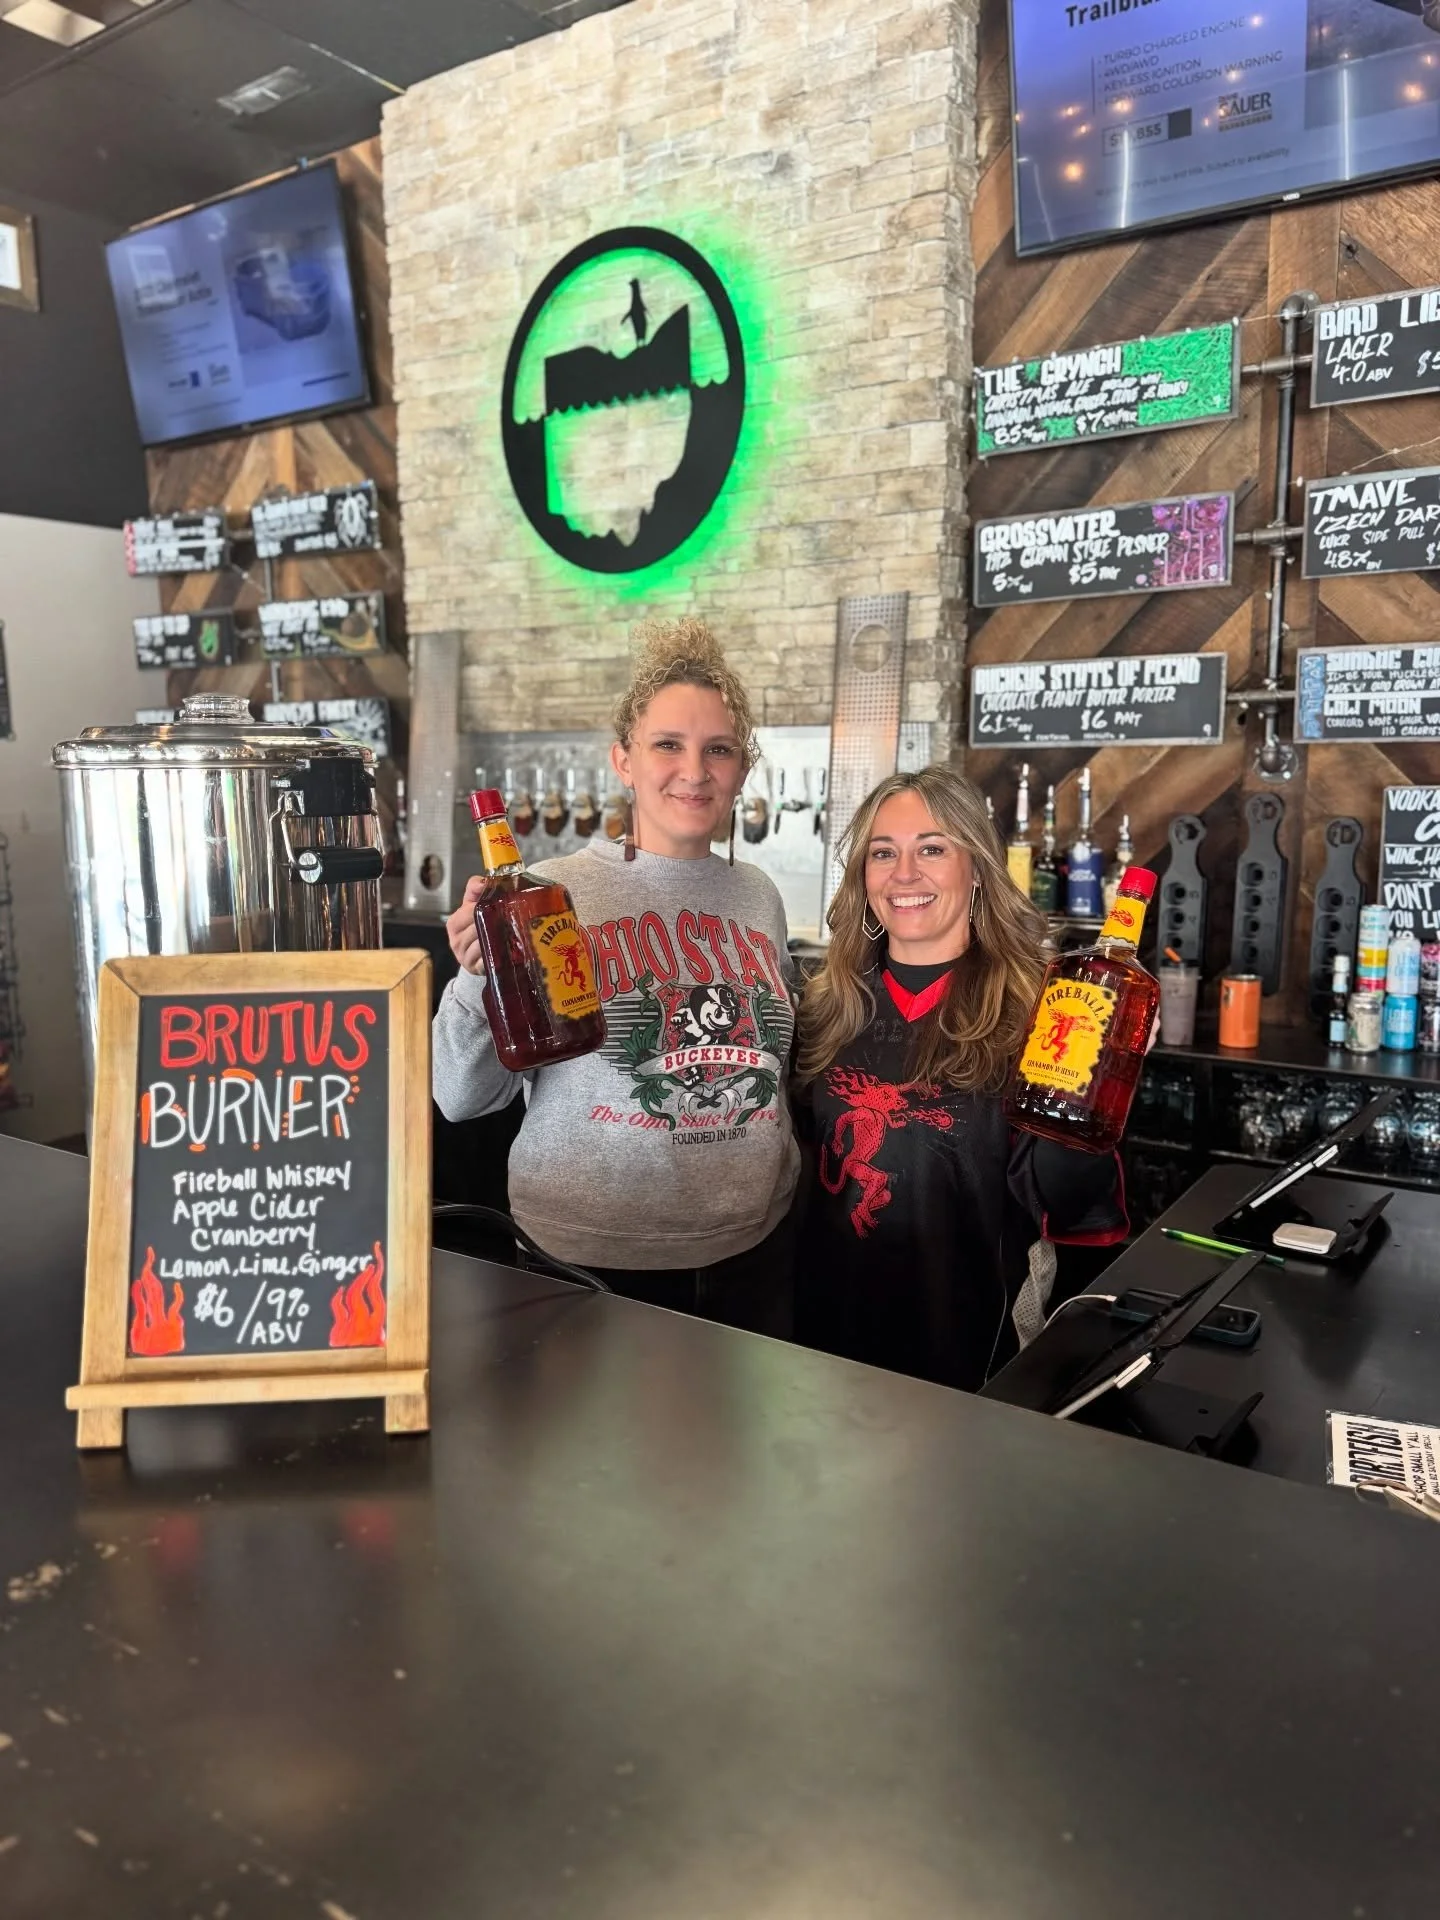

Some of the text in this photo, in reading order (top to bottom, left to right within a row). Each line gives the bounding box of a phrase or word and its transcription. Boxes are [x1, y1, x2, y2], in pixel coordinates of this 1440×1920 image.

[1065, 0, 1160, 27] Trailb
[1103, 16, 1245, 64] TURBO CHARGED ENGINE
[1103, 58, 1201, 92] KEYLESS IGNITION
[1104, 83, 1161, 107] FWARD
[1225, 50, 1283, 76] WARNING
[1219, 92, 1271, 119] SAUER
[1319, 303, 1378, 341] BIRD
[1325, 332, 1394, 365] LAGER
[980, 345, 1122, 397] THE GRYNCH
[1331, 360, 1367, 385] 4.0
[1365, 366, 1394, 382] ABV
[1309, 477, 1417, 515] TMAVE
[980, 509, 1122, 554] GROSSVATER
[1313, 508, 1386, 536] CZECH
[1362, 528, 1391, 545] SIDE
[1397, 525, 1425, 541] PULL
[1068, 560, 1098, 585] $5
[1116, 659, 1141, 687] OF
[1131, 685, 1177, 705] PORTER
[1368, 698, 1421, 716] MOON
[1081, 708, 1109, 731] $6
[1045, 986, 1105, 1017] FIREBALL
[160, 1000, 377, 1071] BRUTUS
[664, 1047, 762, 1072] BUCKEYES
[149, 1074, 352, 1149] BURNER
[589, 1105, 623, 1124] The
[677, 1109, 725, 1128] State
[672, 1126, 747, 1145] FOUNDED IN 1870
[172, 1160, 352, 1196] Fireball Whiskey
[172, 1192, 324, 1227] Apple Cider
[190, 1222, 317, 1252] Cranberry
[193, 1282, 235, 1328] $6
[267, 1287, 310, 1320] 9%
[251, 1320, 303, 1345] ABV
[1409, 1451, 1425, 1474] SMALL
[1412, 1475, 1428, 1495] SHOP
